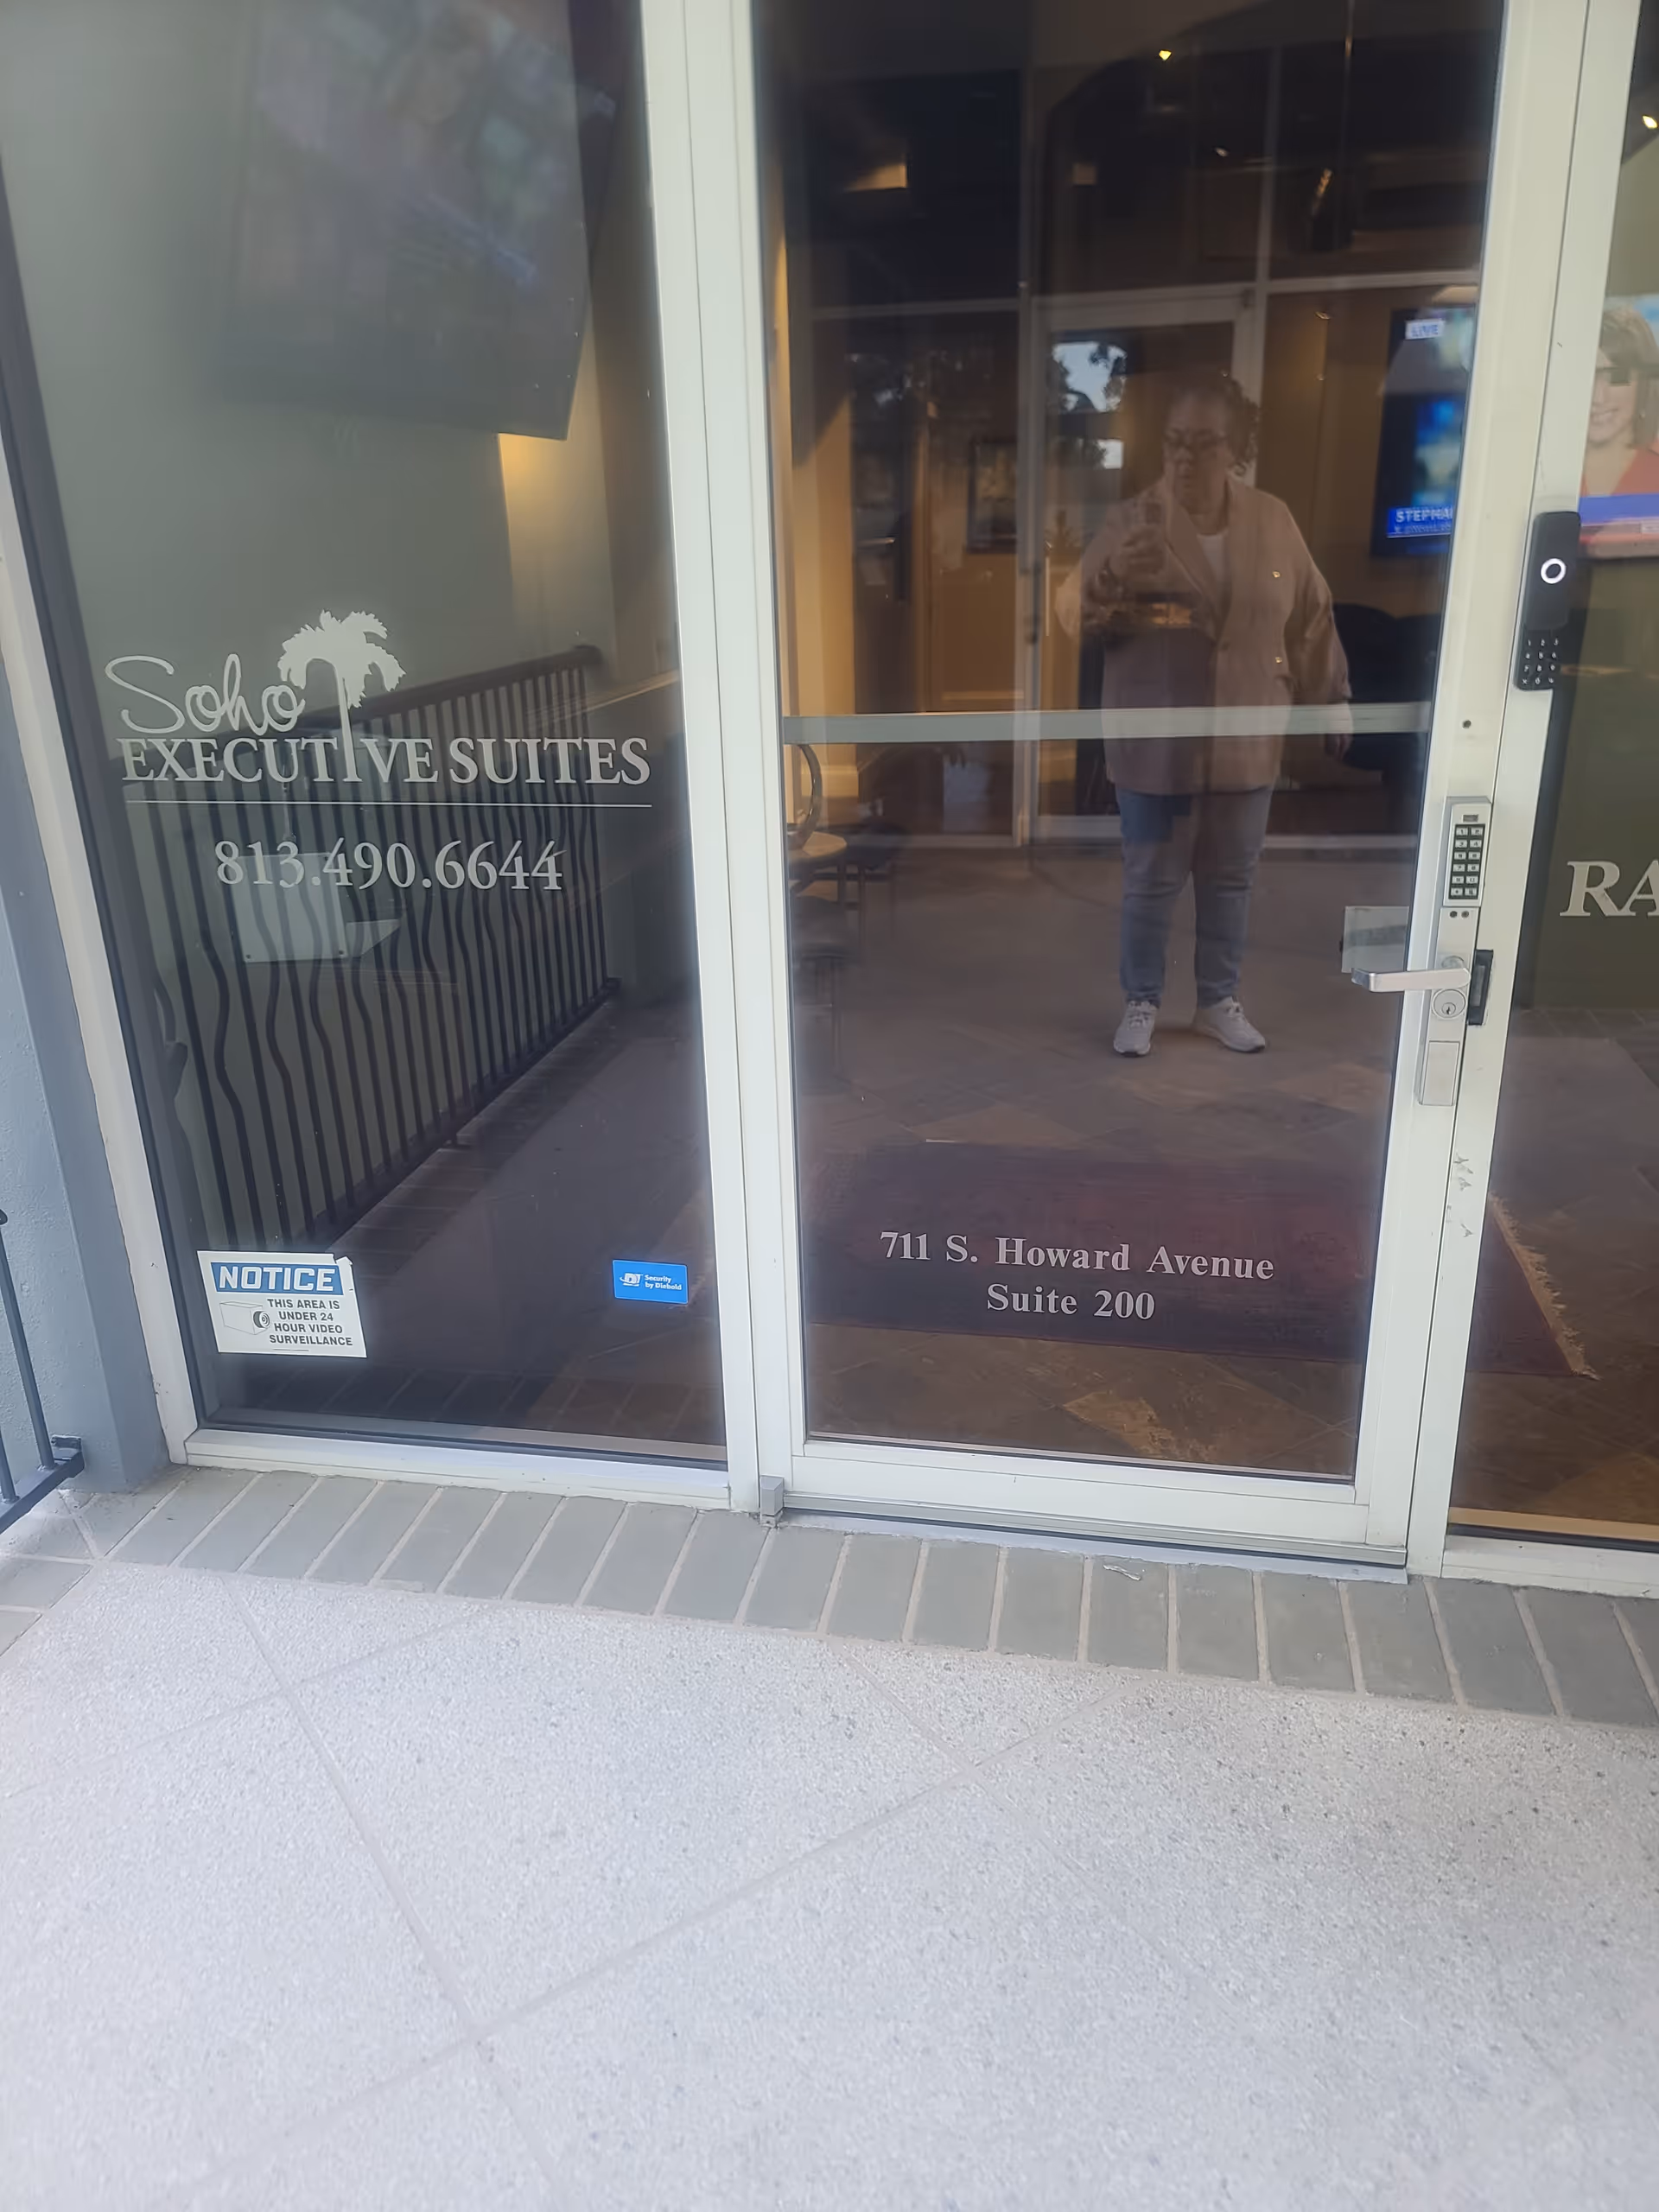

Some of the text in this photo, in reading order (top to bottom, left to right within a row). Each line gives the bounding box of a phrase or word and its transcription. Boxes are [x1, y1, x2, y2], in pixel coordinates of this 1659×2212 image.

[1411, 324, 1439, 337] LIVE
[105, 653, 306, 736] Soho
[116, 737, 651, 785] EXECUTIVE SUITES
[214, 838, 563, 891] 813.490.6644
[1559, 859, 1659, 918] RA
[880, 1231, 1274, 1280] 711 S. Howard Avenue
[219, 1265, 336, 1292] NOTICE
[645, 1274, 672, 1283] Security
[655, 1282, 683, 1291] Diebold
[267, 1299, 340, 1310] THIS AREA IS
[987, 1283, 1156, 1319] Suite 200
[278, 1311, 334, 1322] UNDER 24
[274, 1323, 343, 1334] HOUR VIDEO
[269, 1335, 353, 1346] SURVEILLANCE
